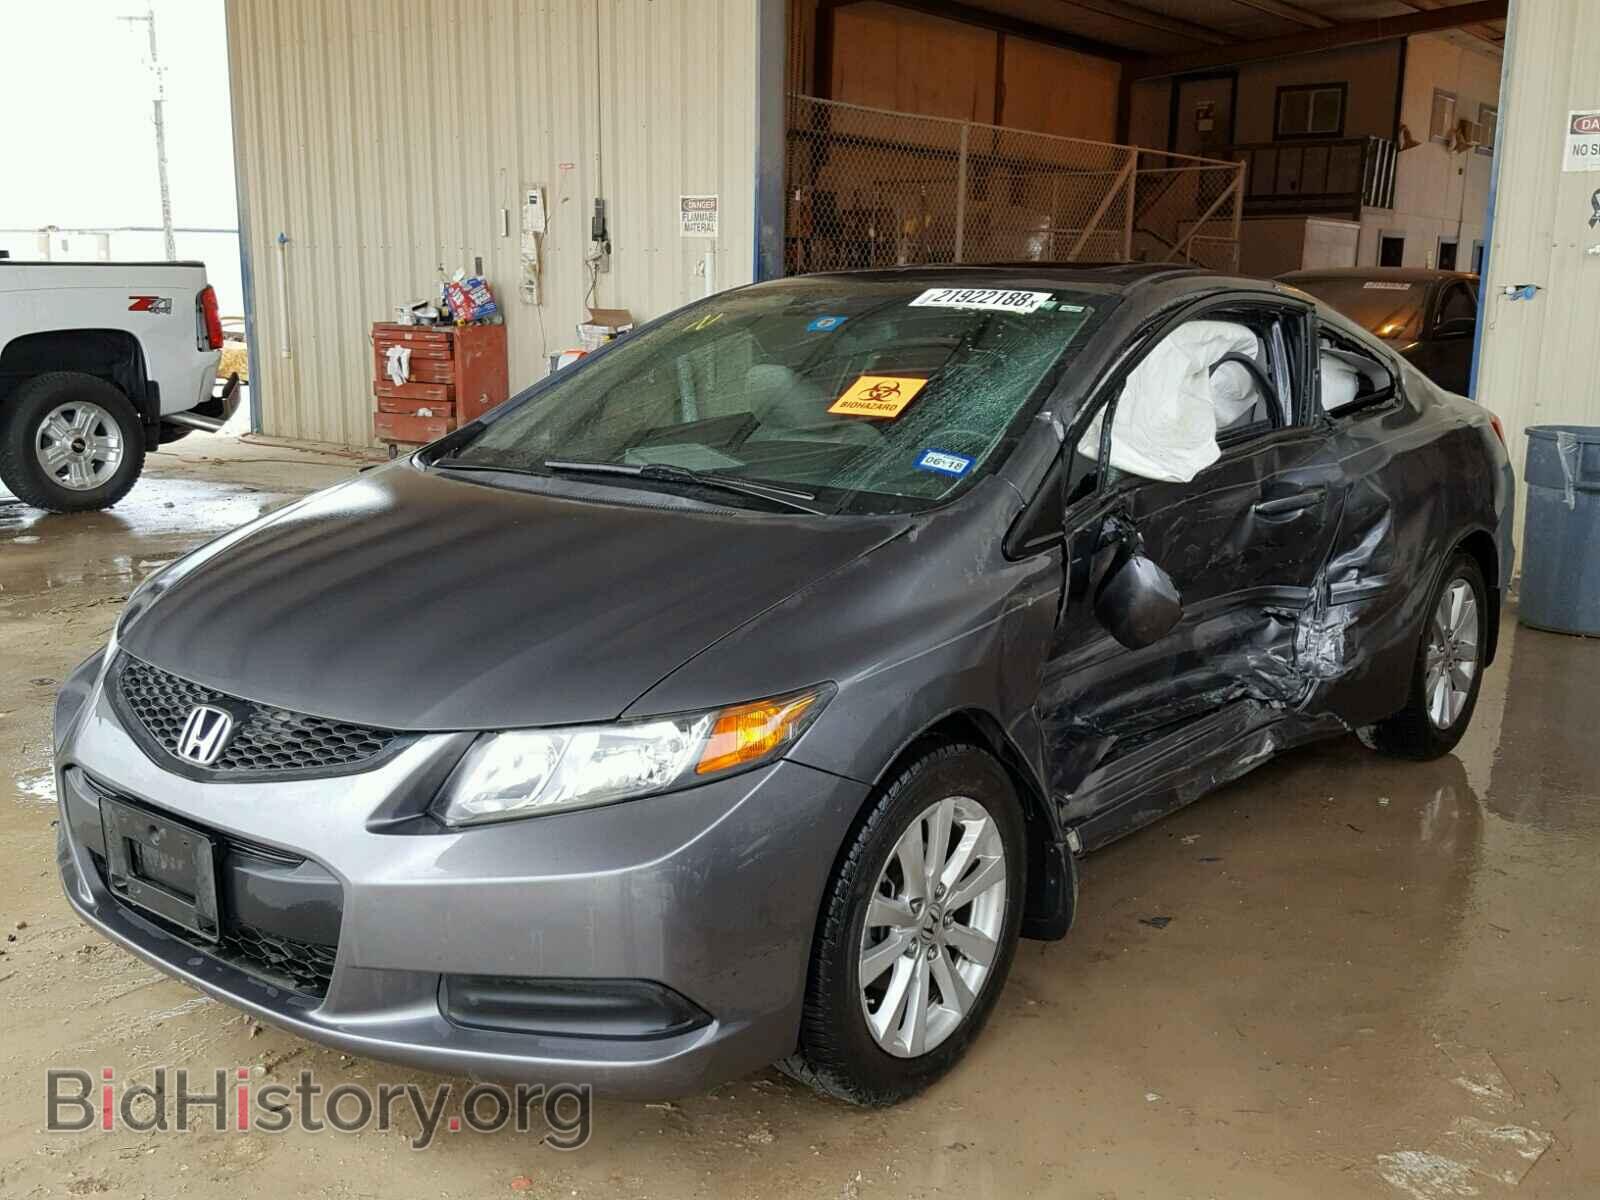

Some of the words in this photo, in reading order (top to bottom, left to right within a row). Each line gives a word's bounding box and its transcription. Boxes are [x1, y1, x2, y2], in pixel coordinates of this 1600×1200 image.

[1572, 144, 1588, 156] NO
[1592, 143, 1600, 155] S
[682, 212, 716, 221] FLAMMAB
[840, 400, 898, 411] BIOHAZARD
